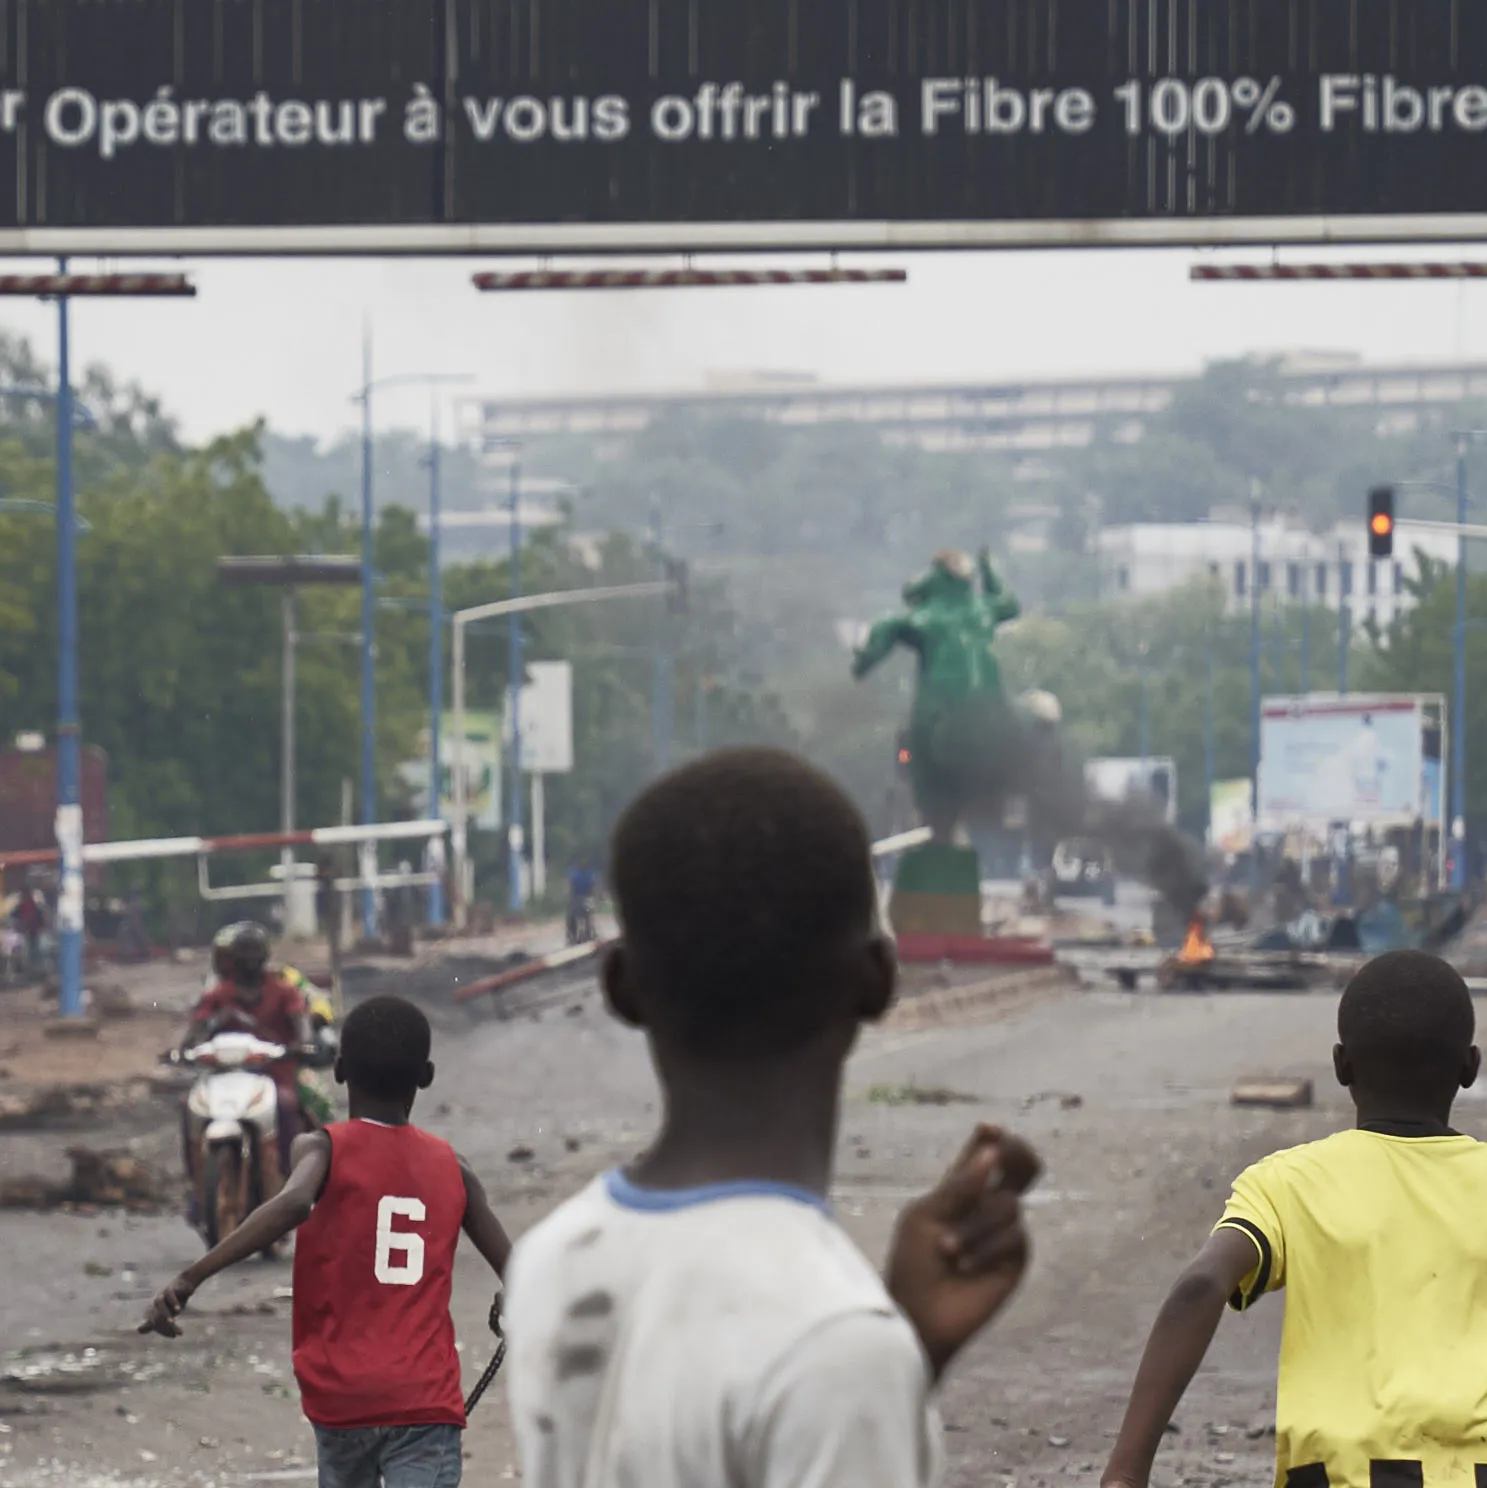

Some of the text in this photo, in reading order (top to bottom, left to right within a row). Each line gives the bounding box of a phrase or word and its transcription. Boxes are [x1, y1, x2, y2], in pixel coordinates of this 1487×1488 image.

[44, 84, 385, 160] Opérateur
[403, 83, 438, 142] à
[461, 92, 630, 142] vous
[650, 80, 818, 142] offrir
[839, 77, 897, 136] la
[920, 76, 1096, 135] Fibre
[1114, 75, 1296, 134] 100%
[374, 1195, 426, 1285] 6
